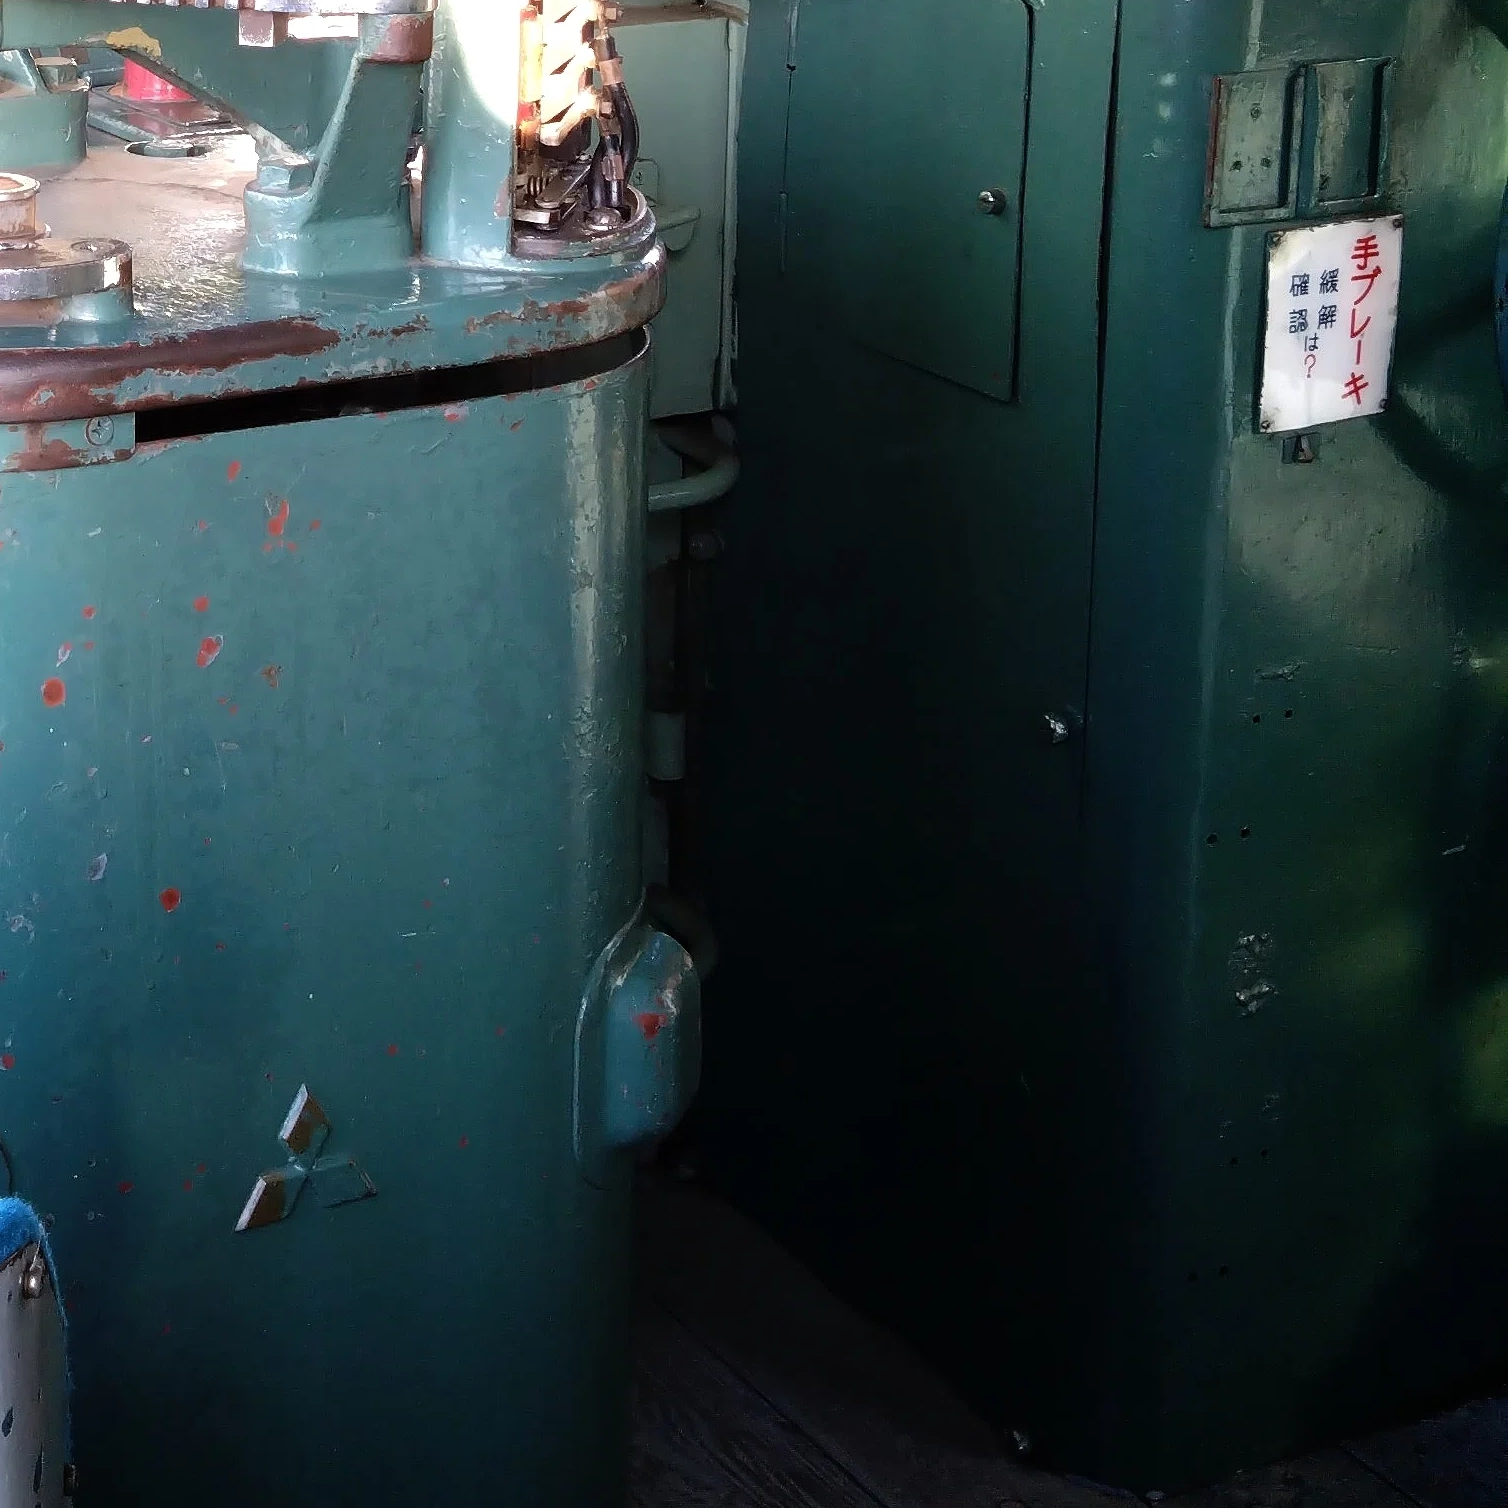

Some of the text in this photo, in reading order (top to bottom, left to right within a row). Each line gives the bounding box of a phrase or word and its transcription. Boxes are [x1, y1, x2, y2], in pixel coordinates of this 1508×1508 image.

[1289, 272, 1311, 334] 確認
[1317, 267, 1339, 330] 緩解
[1342, 234, 1382, 405] 手ブレーキ
